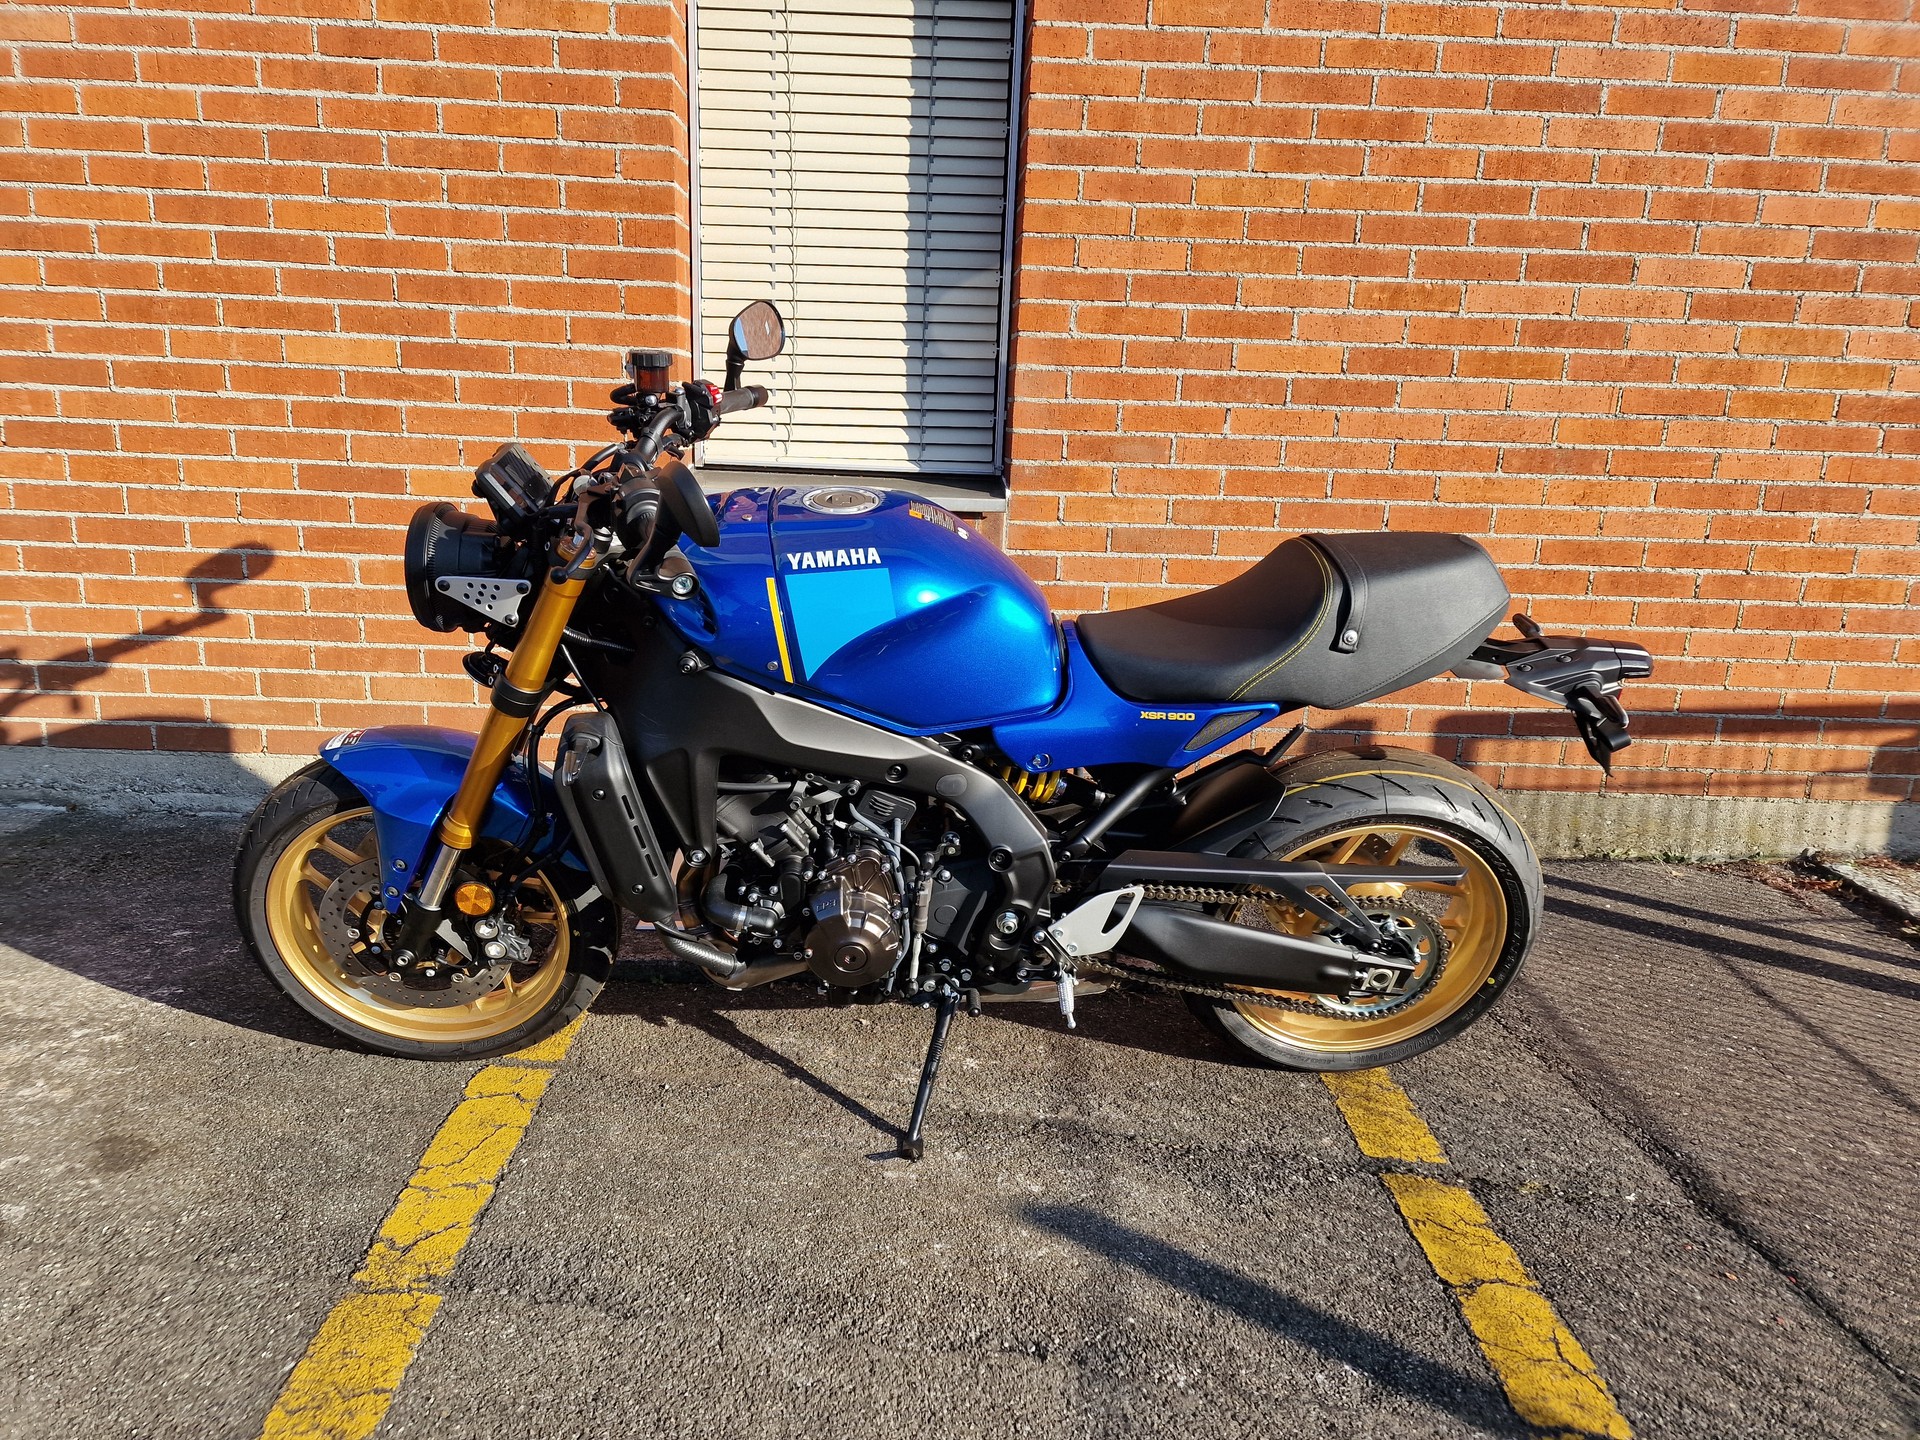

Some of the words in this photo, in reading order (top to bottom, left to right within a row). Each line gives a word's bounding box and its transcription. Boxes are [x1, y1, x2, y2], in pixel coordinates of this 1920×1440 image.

[786, 547, 882, 570] YAMAHA
[1140, 711, 1167, 720] XSR
[1167, 712, 1196, 721] 900
